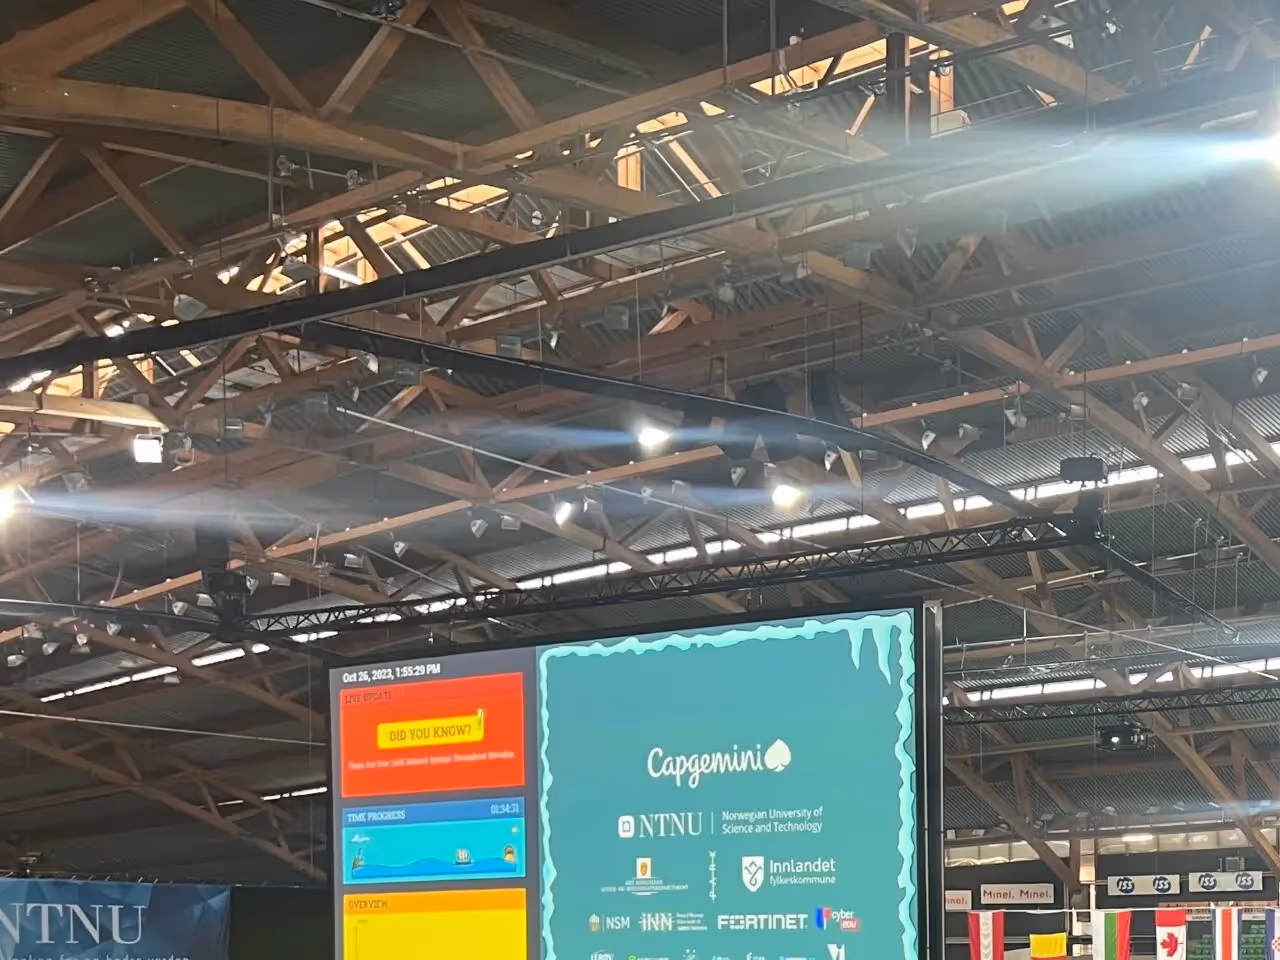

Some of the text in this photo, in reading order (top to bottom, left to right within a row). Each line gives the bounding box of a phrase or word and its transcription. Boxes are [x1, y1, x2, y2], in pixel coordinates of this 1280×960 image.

[343, 672, 357, 683] Oct
[358, 670, 371, 683] 26,
[372, 668, 394, 680] 2023,
[426, 663, 441, 674] PM
[389, 724, 472, 742] DID YOU KNOW?
[647, 743, 764, 789] Capgemini
[367, 810, 406, 822] PROGRESS
[722, 805, 824, 823] Norwegian University of
[639, 812, 703, 838] NTNU
[722, 820, 822, 834] Science and Technology
[770, 857, 836, 873] Innlandet
[770, 875, 836, 887] fylkeskommune
[348, 899, 388, 910] OVERVIEW
[945, 896, 968, 905] inel.
[606, 916, 630, 930] NSM
[717, 913, 808, 930] FORTINET
[831, 908, 854, 922] cyber
[0, 902, 148, 945] NTNU
